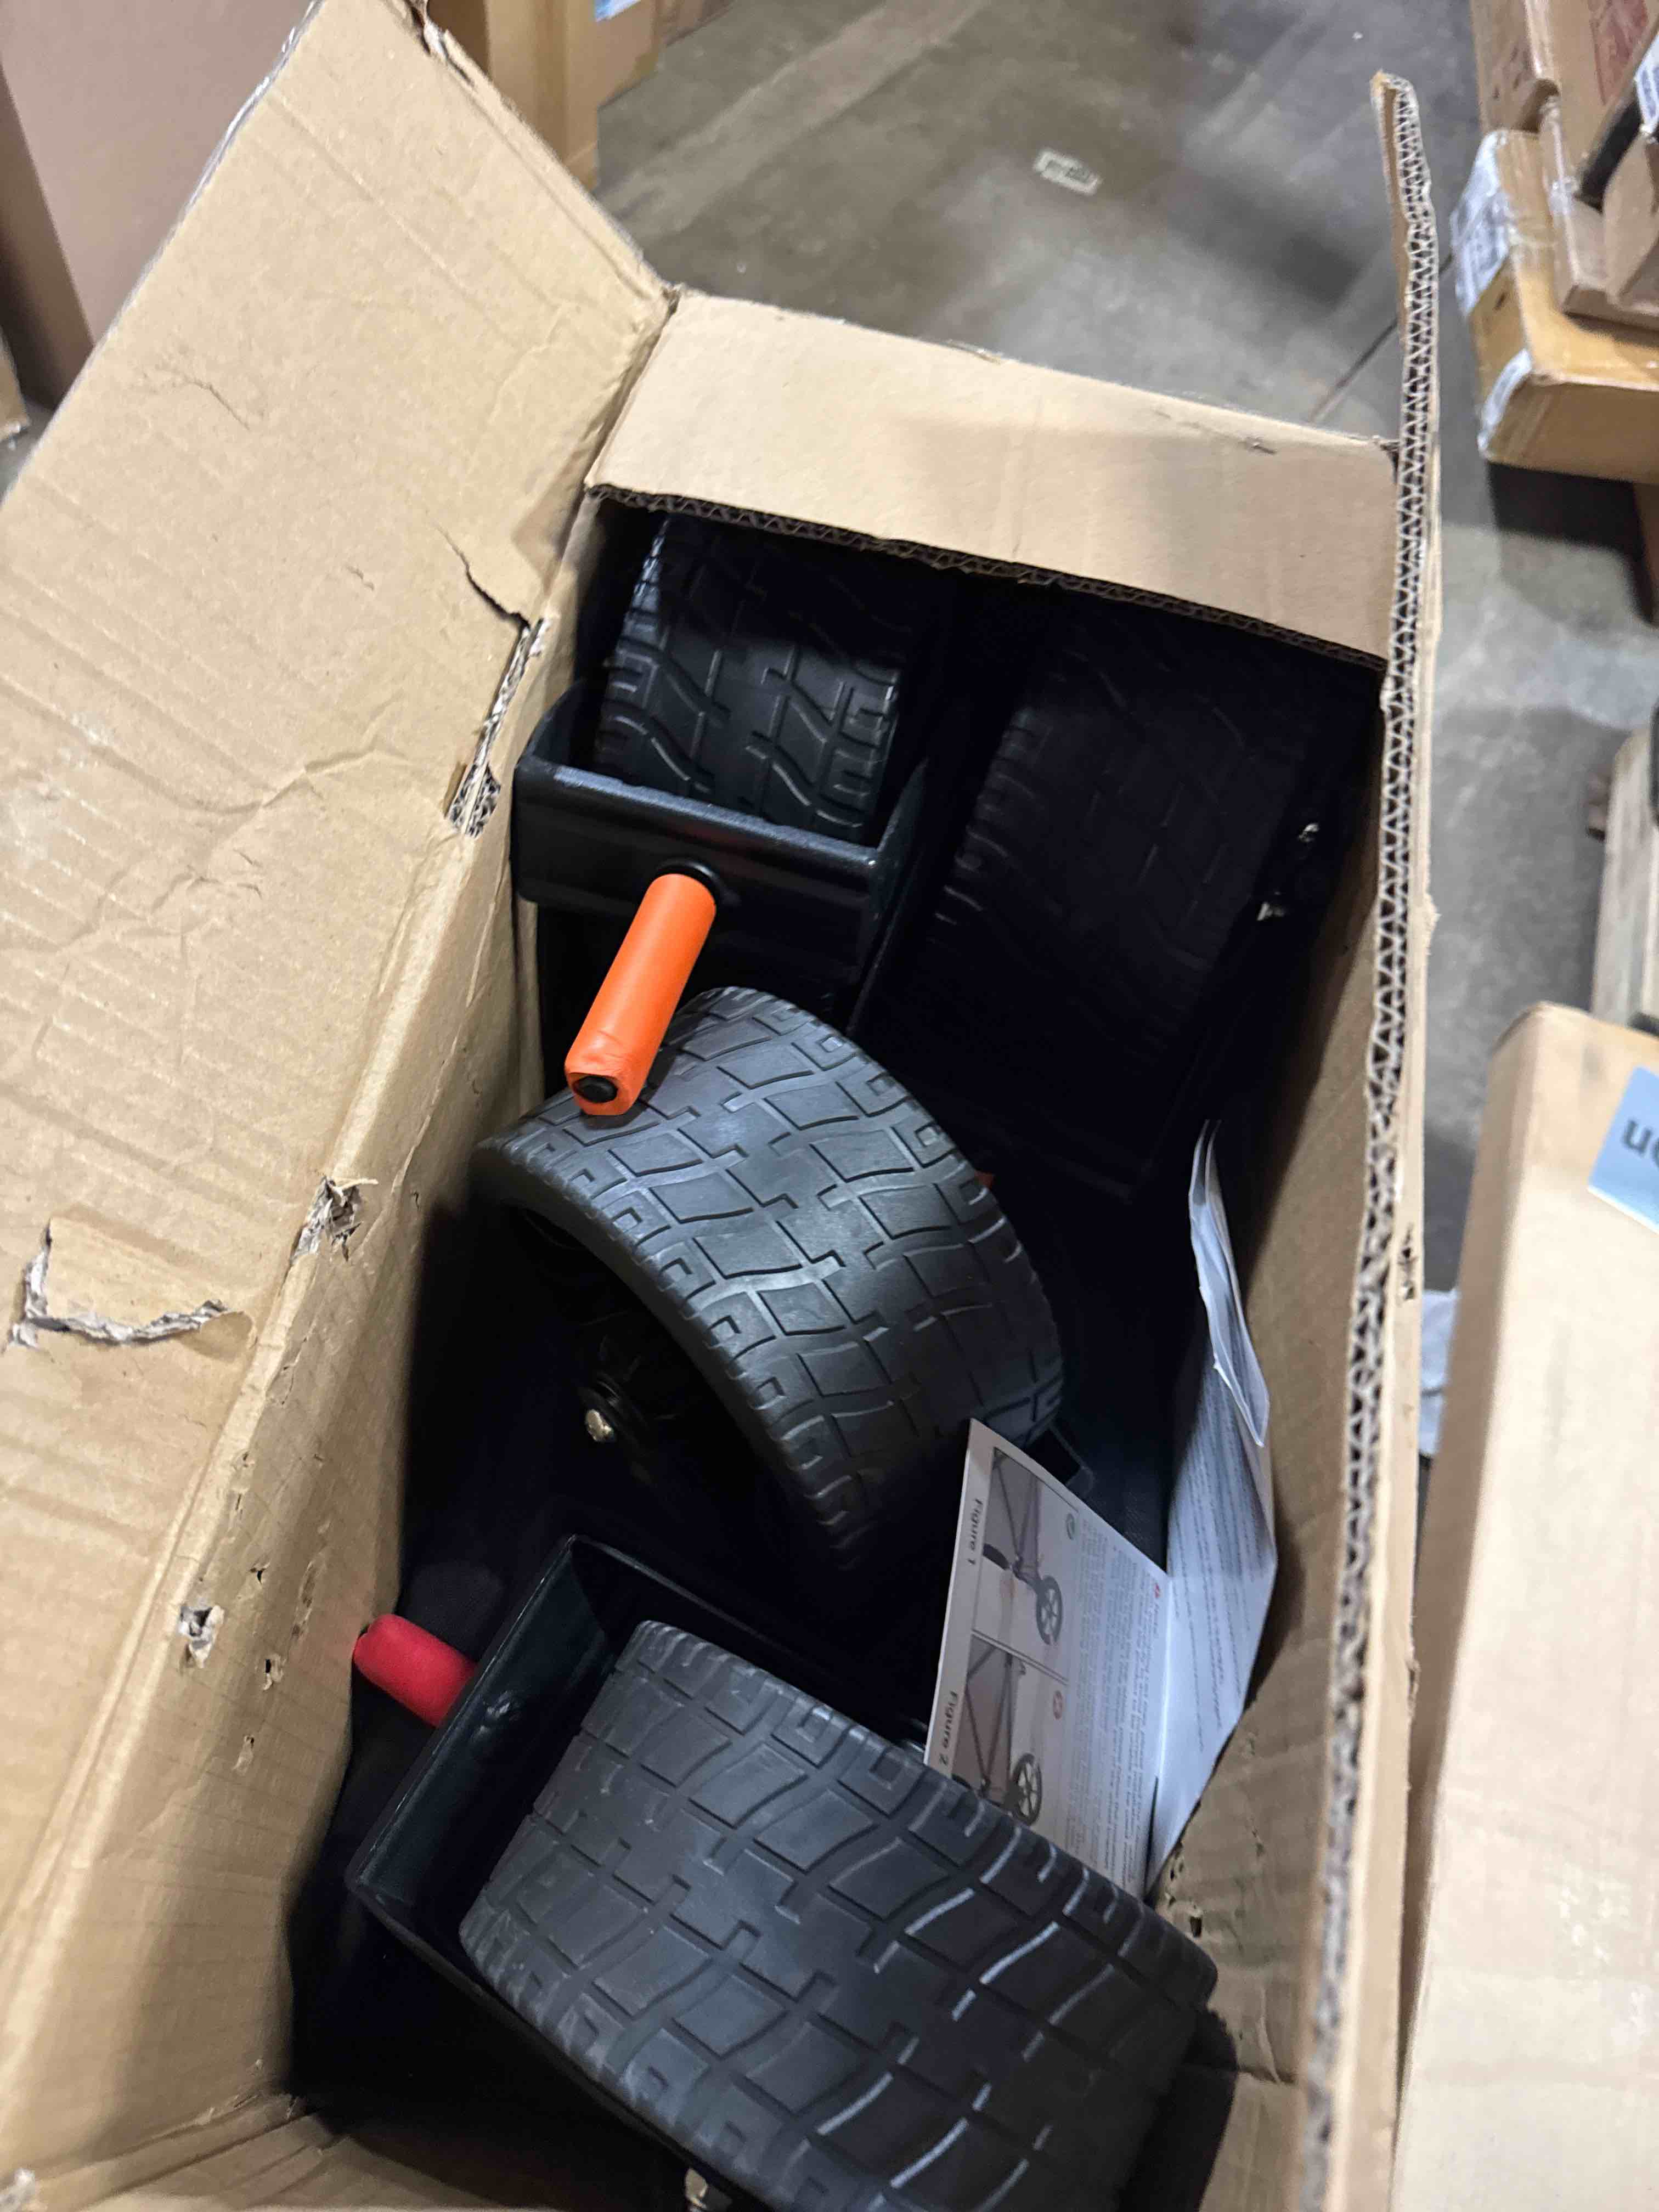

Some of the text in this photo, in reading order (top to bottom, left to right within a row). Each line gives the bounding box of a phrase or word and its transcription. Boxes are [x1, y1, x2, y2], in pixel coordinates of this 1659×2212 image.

[970, 1498, 983, 1553] Figure
[939, 1690, 958, 1766] Figure 2
